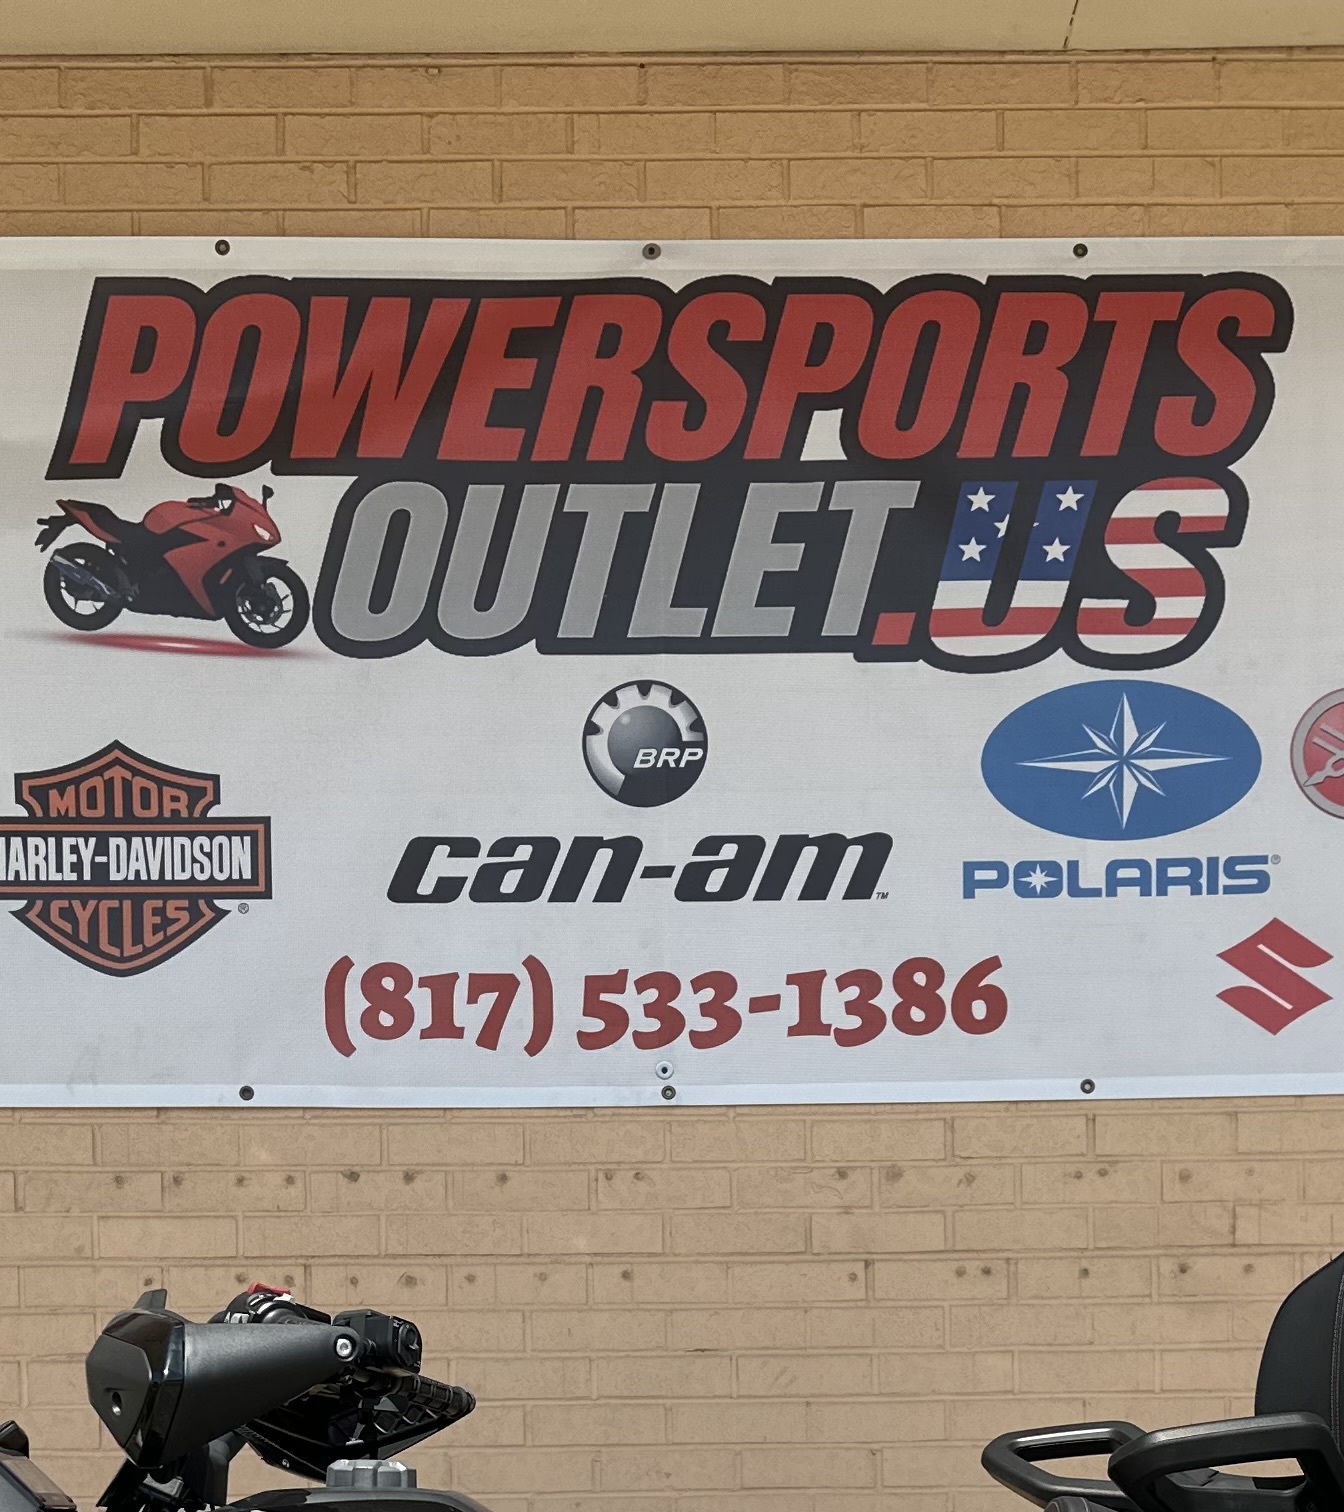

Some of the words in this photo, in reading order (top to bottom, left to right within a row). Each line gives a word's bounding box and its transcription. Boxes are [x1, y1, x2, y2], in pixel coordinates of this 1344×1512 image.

[64, 286, 1280, 468] POWERSPORTS
[337, 476, 1239, 646] OUTLET.US
[48, 764, 190, 818] MOTOR
[633, 747, 704, 769] BRP
[385, 831, 895, 904] can-am
[961, 854, 1272, 900] POLARIS
[49, 899, 191, 958] CYCLES
[323, 953, 555, 1059] (817)
[575, 955, 1009, 1051] 533-1386
